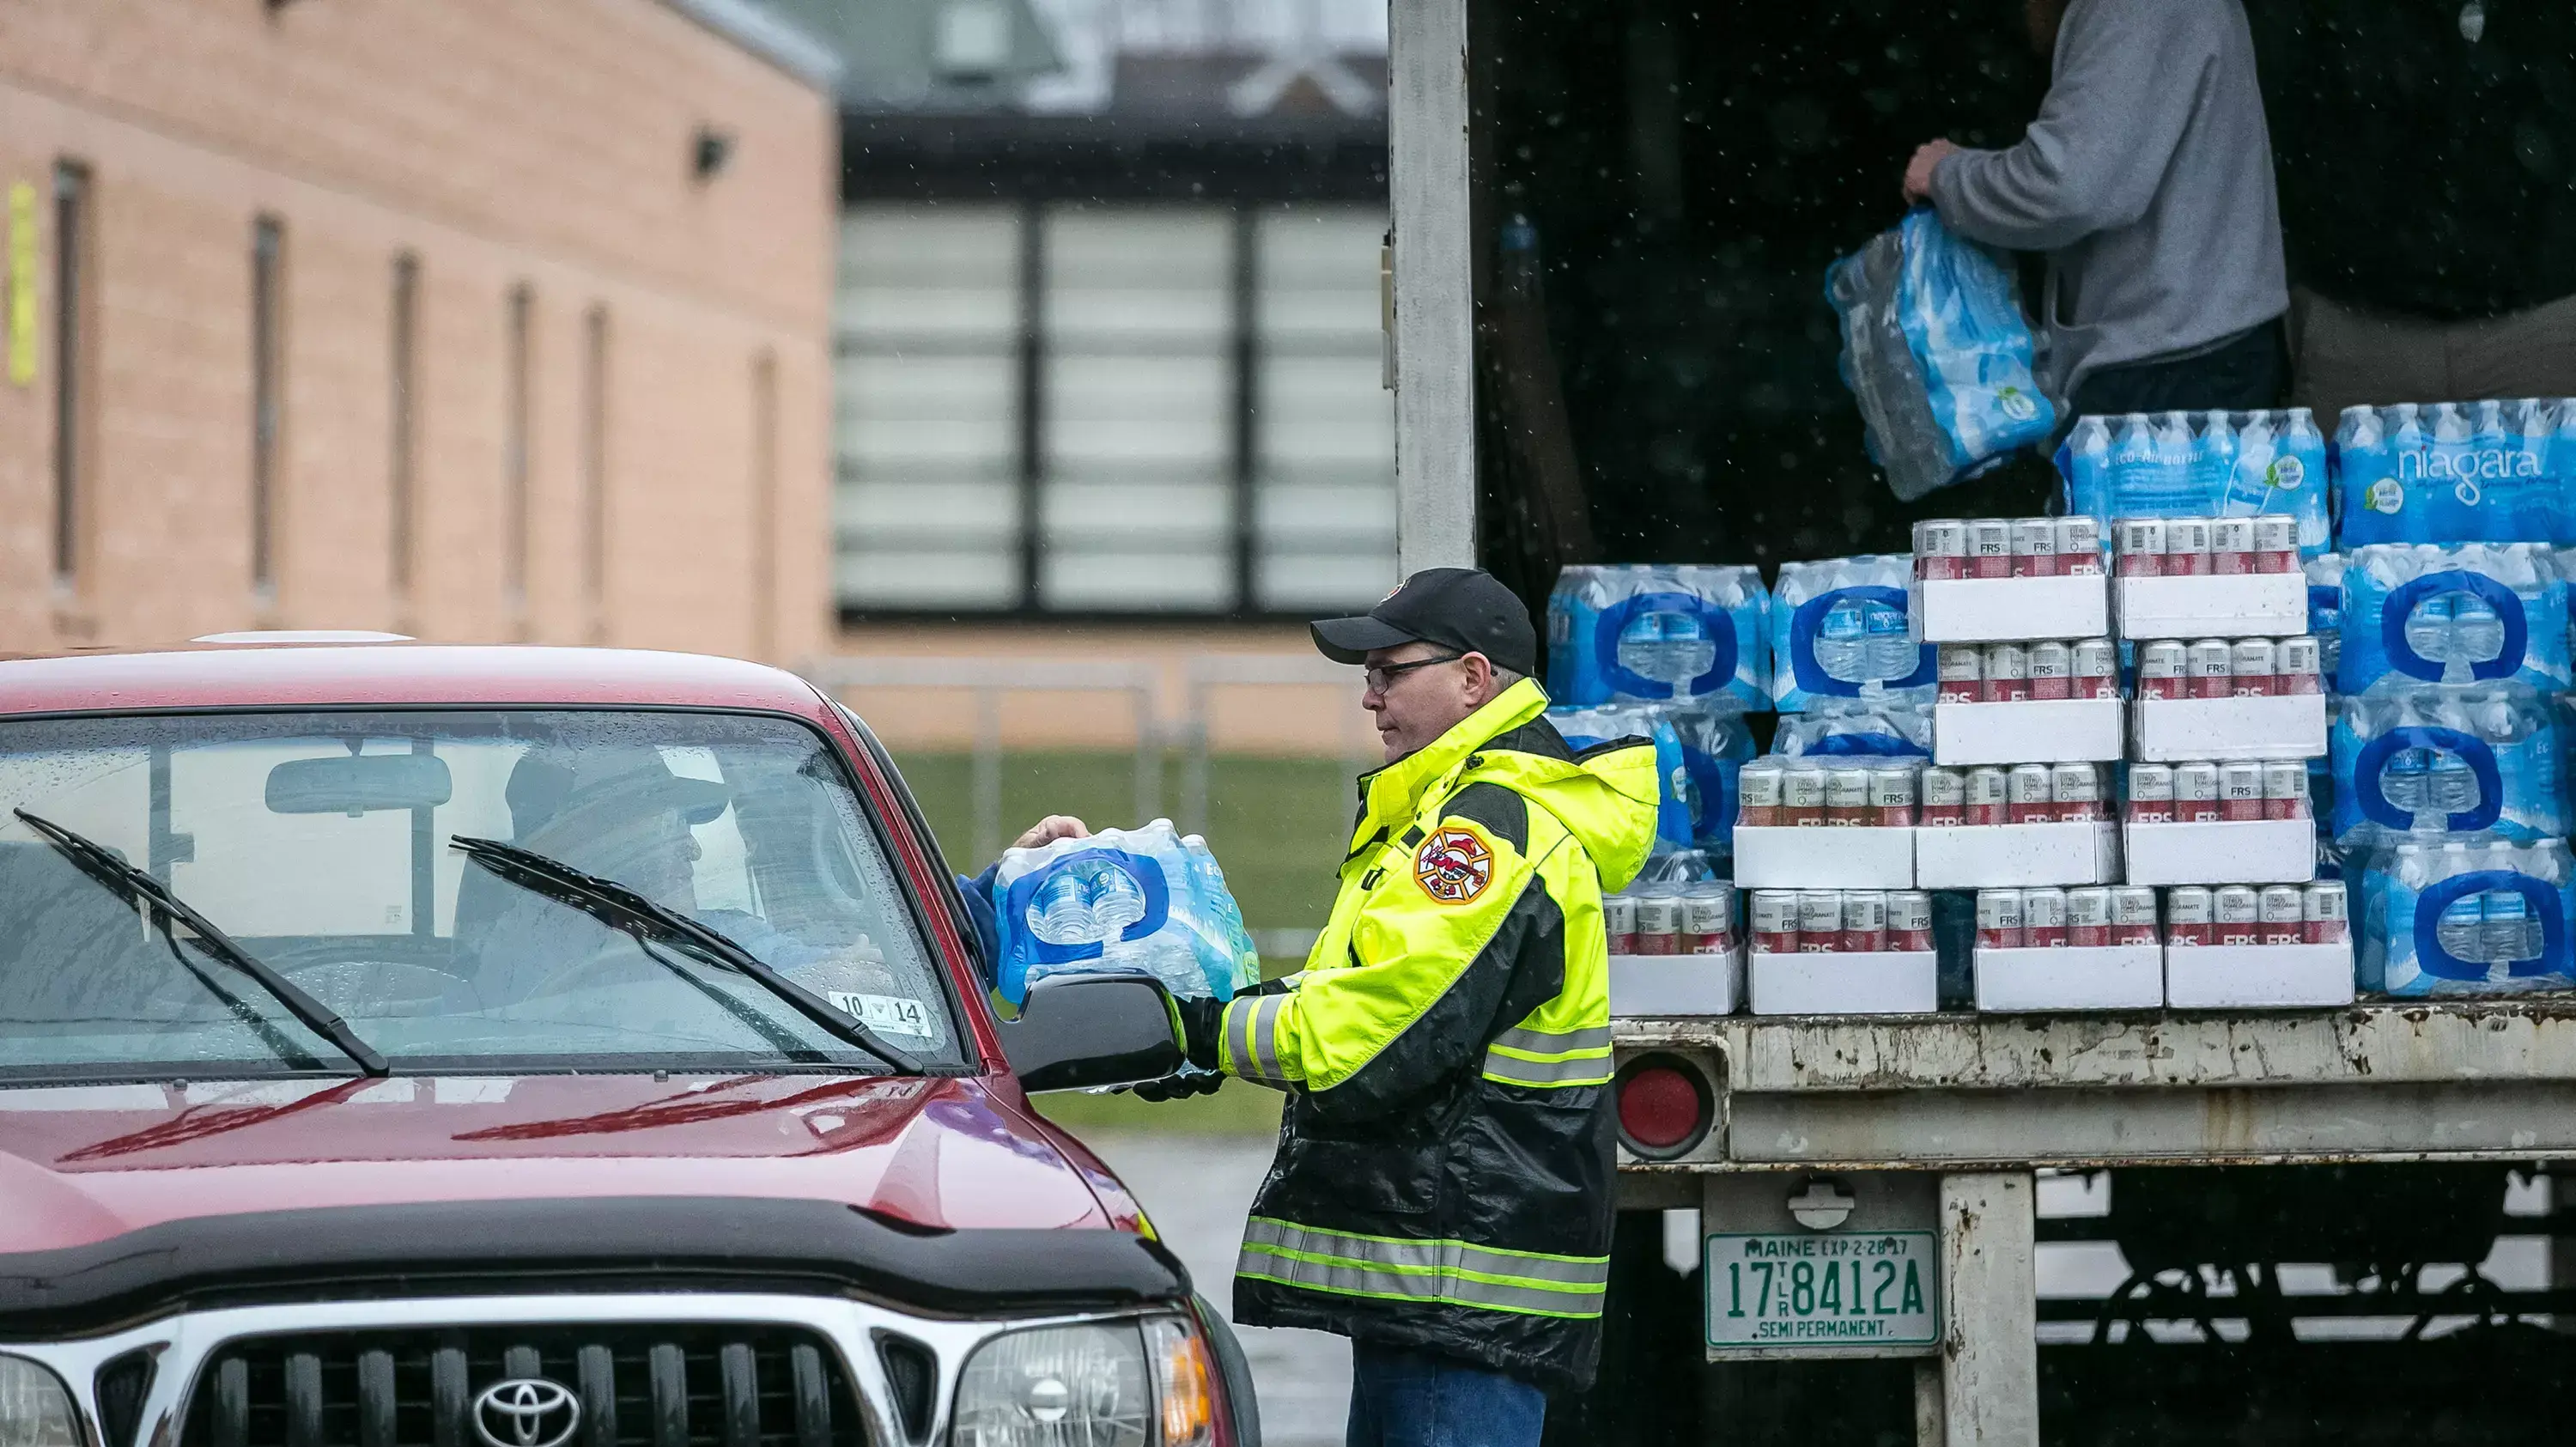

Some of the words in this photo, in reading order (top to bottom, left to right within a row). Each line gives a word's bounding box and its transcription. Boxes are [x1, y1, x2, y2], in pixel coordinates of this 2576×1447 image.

[2398, 445, 2542, 506] niagara
[1980, 543, 2000, 554] FRS
[2034, 542, 2052, 552] FRS
[2033, 665, 2053, 675] FRS
[2173, 665, 2186, 674] FR
[2207, 664, 2226, 674] FRS
[2231, 787, 2251, 796] FRS
[1884, 793, 1904, 803] FRS
[1911, 917, 1929, 927] FRS
[2000, 915, 2018, 925] FRS
[842, 995, 864, 1016] 10
[895, 1001, 921, 1024] 14
[1745, 1239, 1816, 1257] MAINE
[1822, 1240, 1848, 1255] EXP
[1759, 1321, 1794, 1338] SEMI
[1797, 1319, 1885, 1337] PERMANENT
